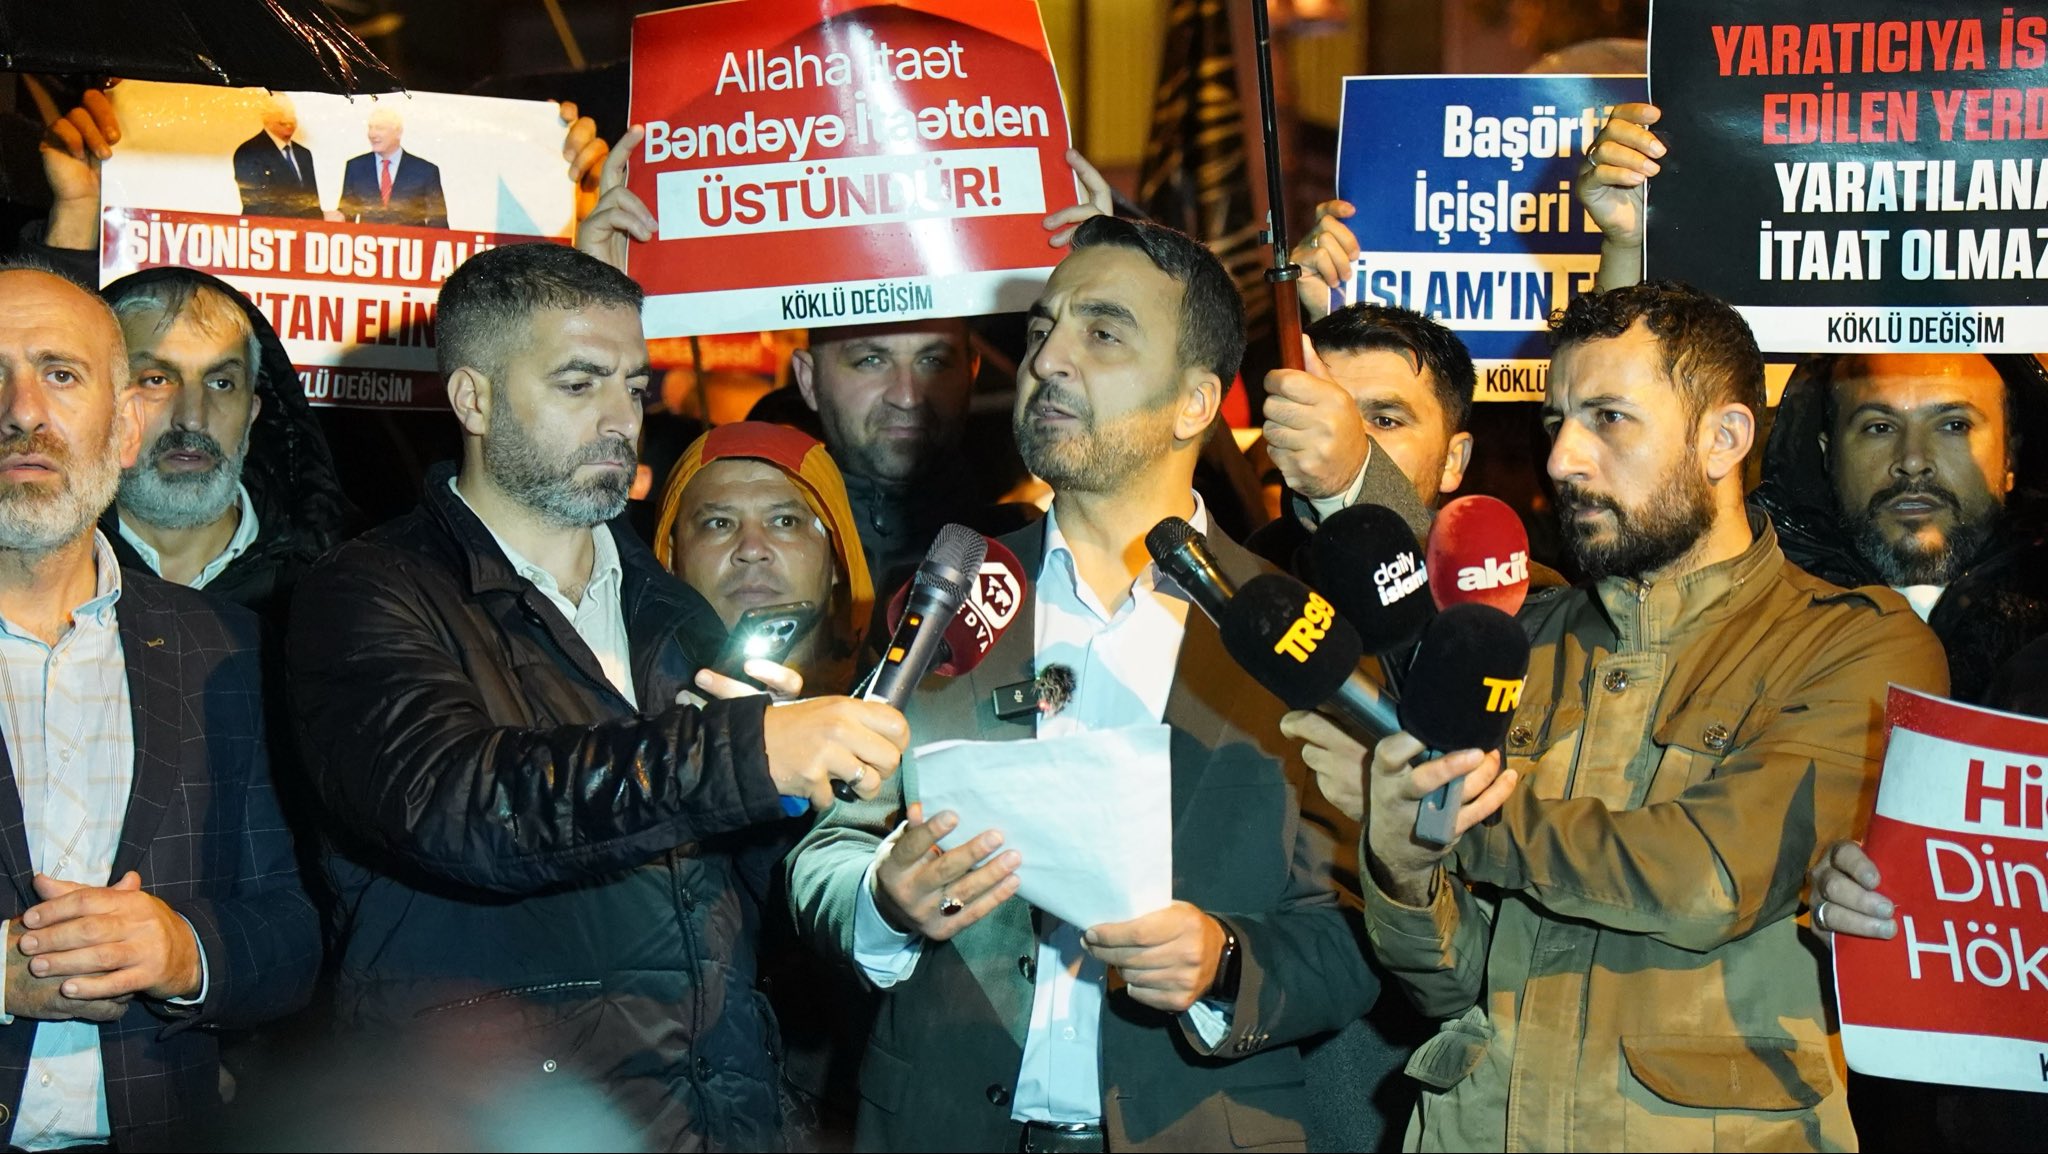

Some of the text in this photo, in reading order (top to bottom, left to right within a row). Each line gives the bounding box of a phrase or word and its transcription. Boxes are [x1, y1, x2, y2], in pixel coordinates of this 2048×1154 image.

[714, 45, 851, 95] Allaha
[1712, 18, 1985, 76] YARATICIYA
[643, 110, 846, 162] Bəndəyə
[1763, 82, 2048, 145] EDİLEN YERD
[698, 157, 1002, 228] ÜSTÜNDÜR!
[1415, 169, 1570, 245] İçişleri
[127, 213, 297, 272] SİYONİST
[305, 231, 423, 281] DOSTU
[1759, 220, 1890, 281] İTAAT
[240, 290, 437, 348] 'TAN ELİN
[782, 282, 933, 321] KÖKLÜ DEĞİŞİM
[1828, 311, 2004, 348] KÖKLÜ DEĞİŞİM
[333, 370, 412, 404] DEĞİŞİM
[1485, 364, 1547, 393] KÖKLÜ
[1373, 551, 1415, 586] daily
[1457, 550, 1529, 592] akit
[1274, 591, 1335, 663] TR99
[1483, 676, 1526, 712] TR
[1964, 758, 2048, 830] Hi
[1925, 838, 2048, 913] Din
[1903, 915, 2048, 991] Hök
